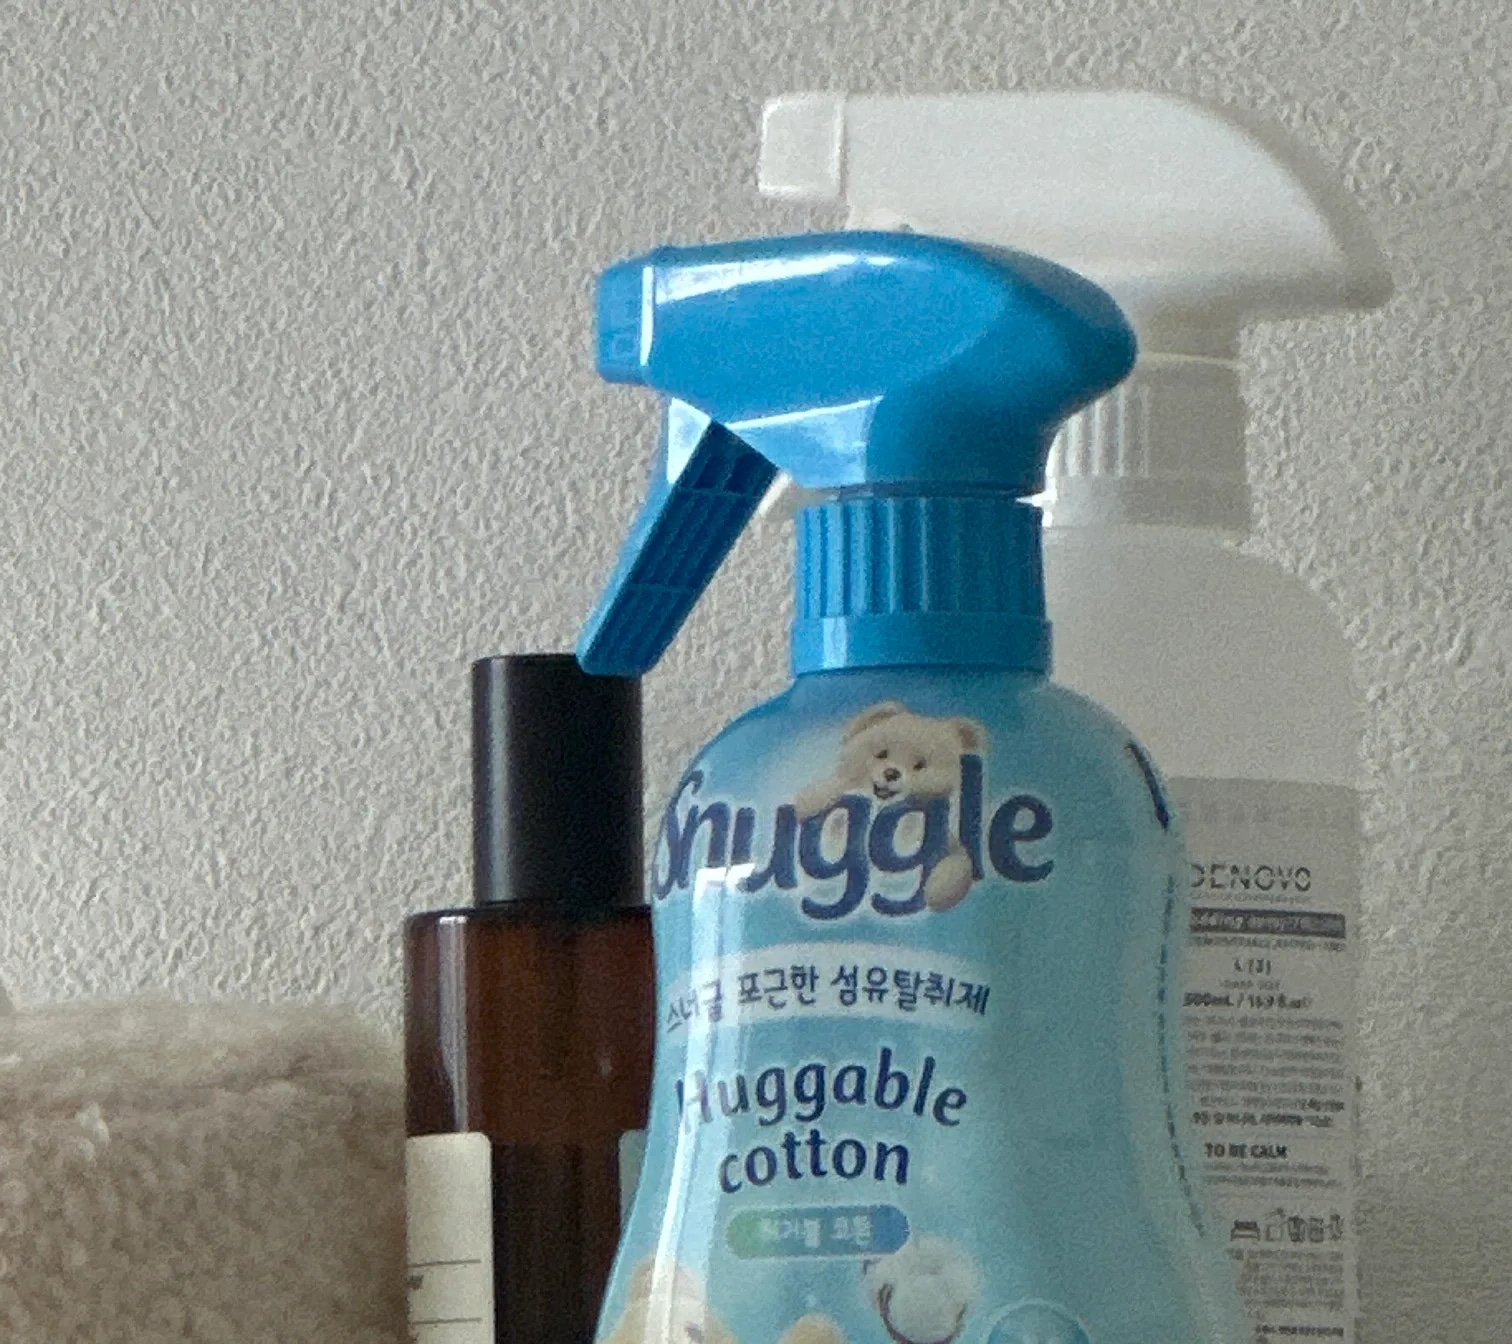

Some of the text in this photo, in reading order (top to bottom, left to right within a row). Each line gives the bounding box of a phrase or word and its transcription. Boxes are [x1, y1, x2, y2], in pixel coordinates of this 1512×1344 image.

[737, 964, 820, 1011] 포근한
[831, 964, 990, 1017] 섬유탈취제
[675, 1047, 968, 1127] Huggable
[720, 1129, 910, 1194] cotton
